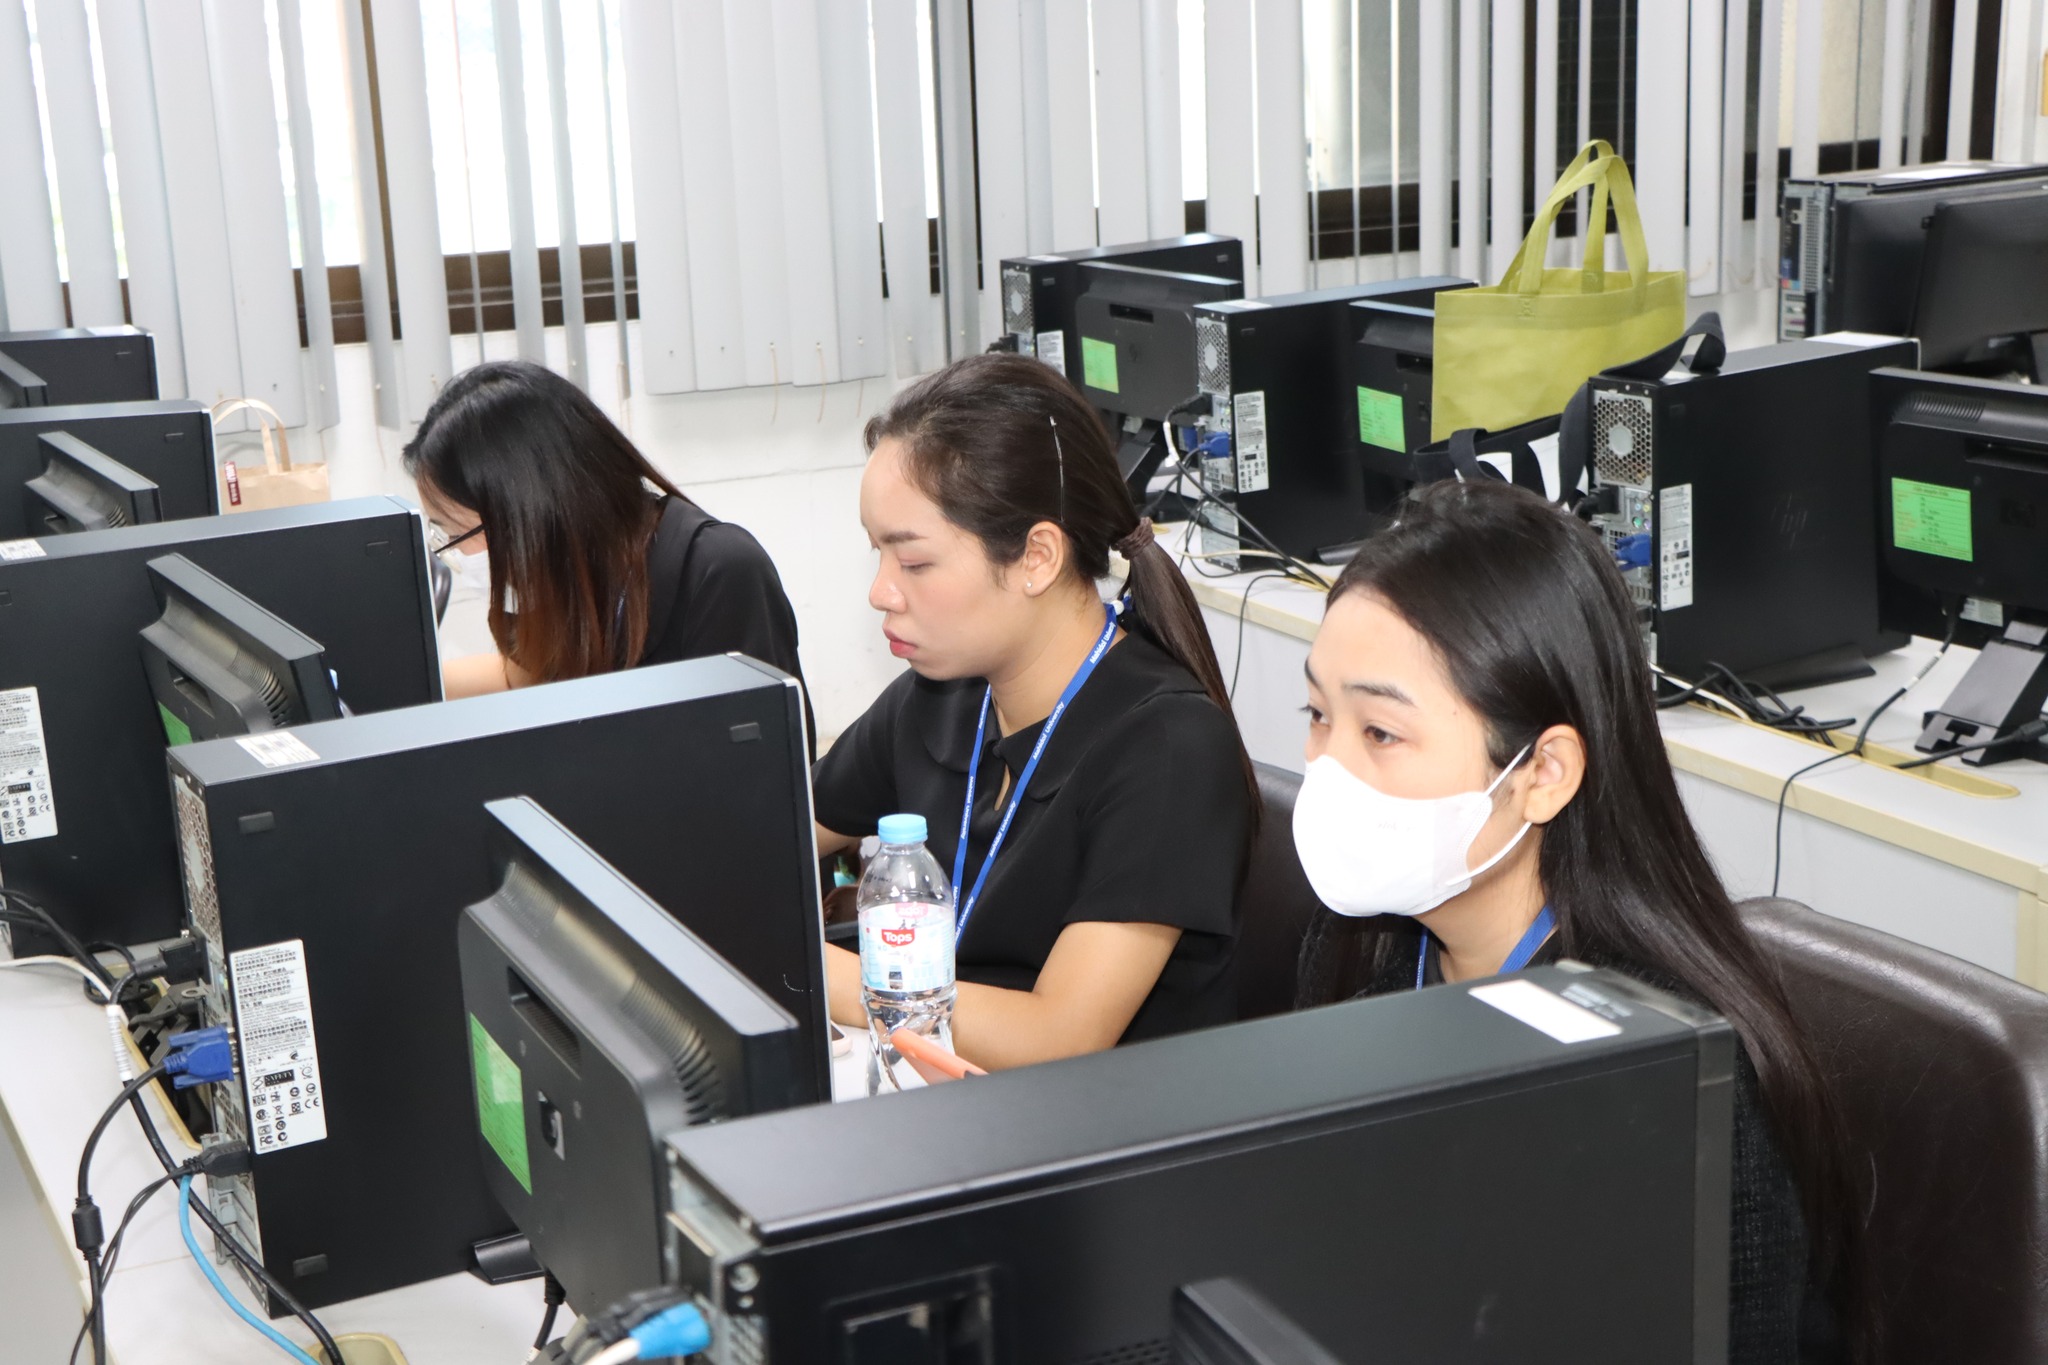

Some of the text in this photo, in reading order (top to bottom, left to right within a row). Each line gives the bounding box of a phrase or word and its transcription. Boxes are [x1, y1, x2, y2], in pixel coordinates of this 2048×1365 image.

[1089, 639, 1108, 664] Mahidol
[1032, 701, 1065, 760] Mahidol University
[960, 805, 970, 839] University
[989, 800, 1016, 858] Mahidol University
[960, 896, 974, 927] University
[884, 931, 913, 944] Tops
